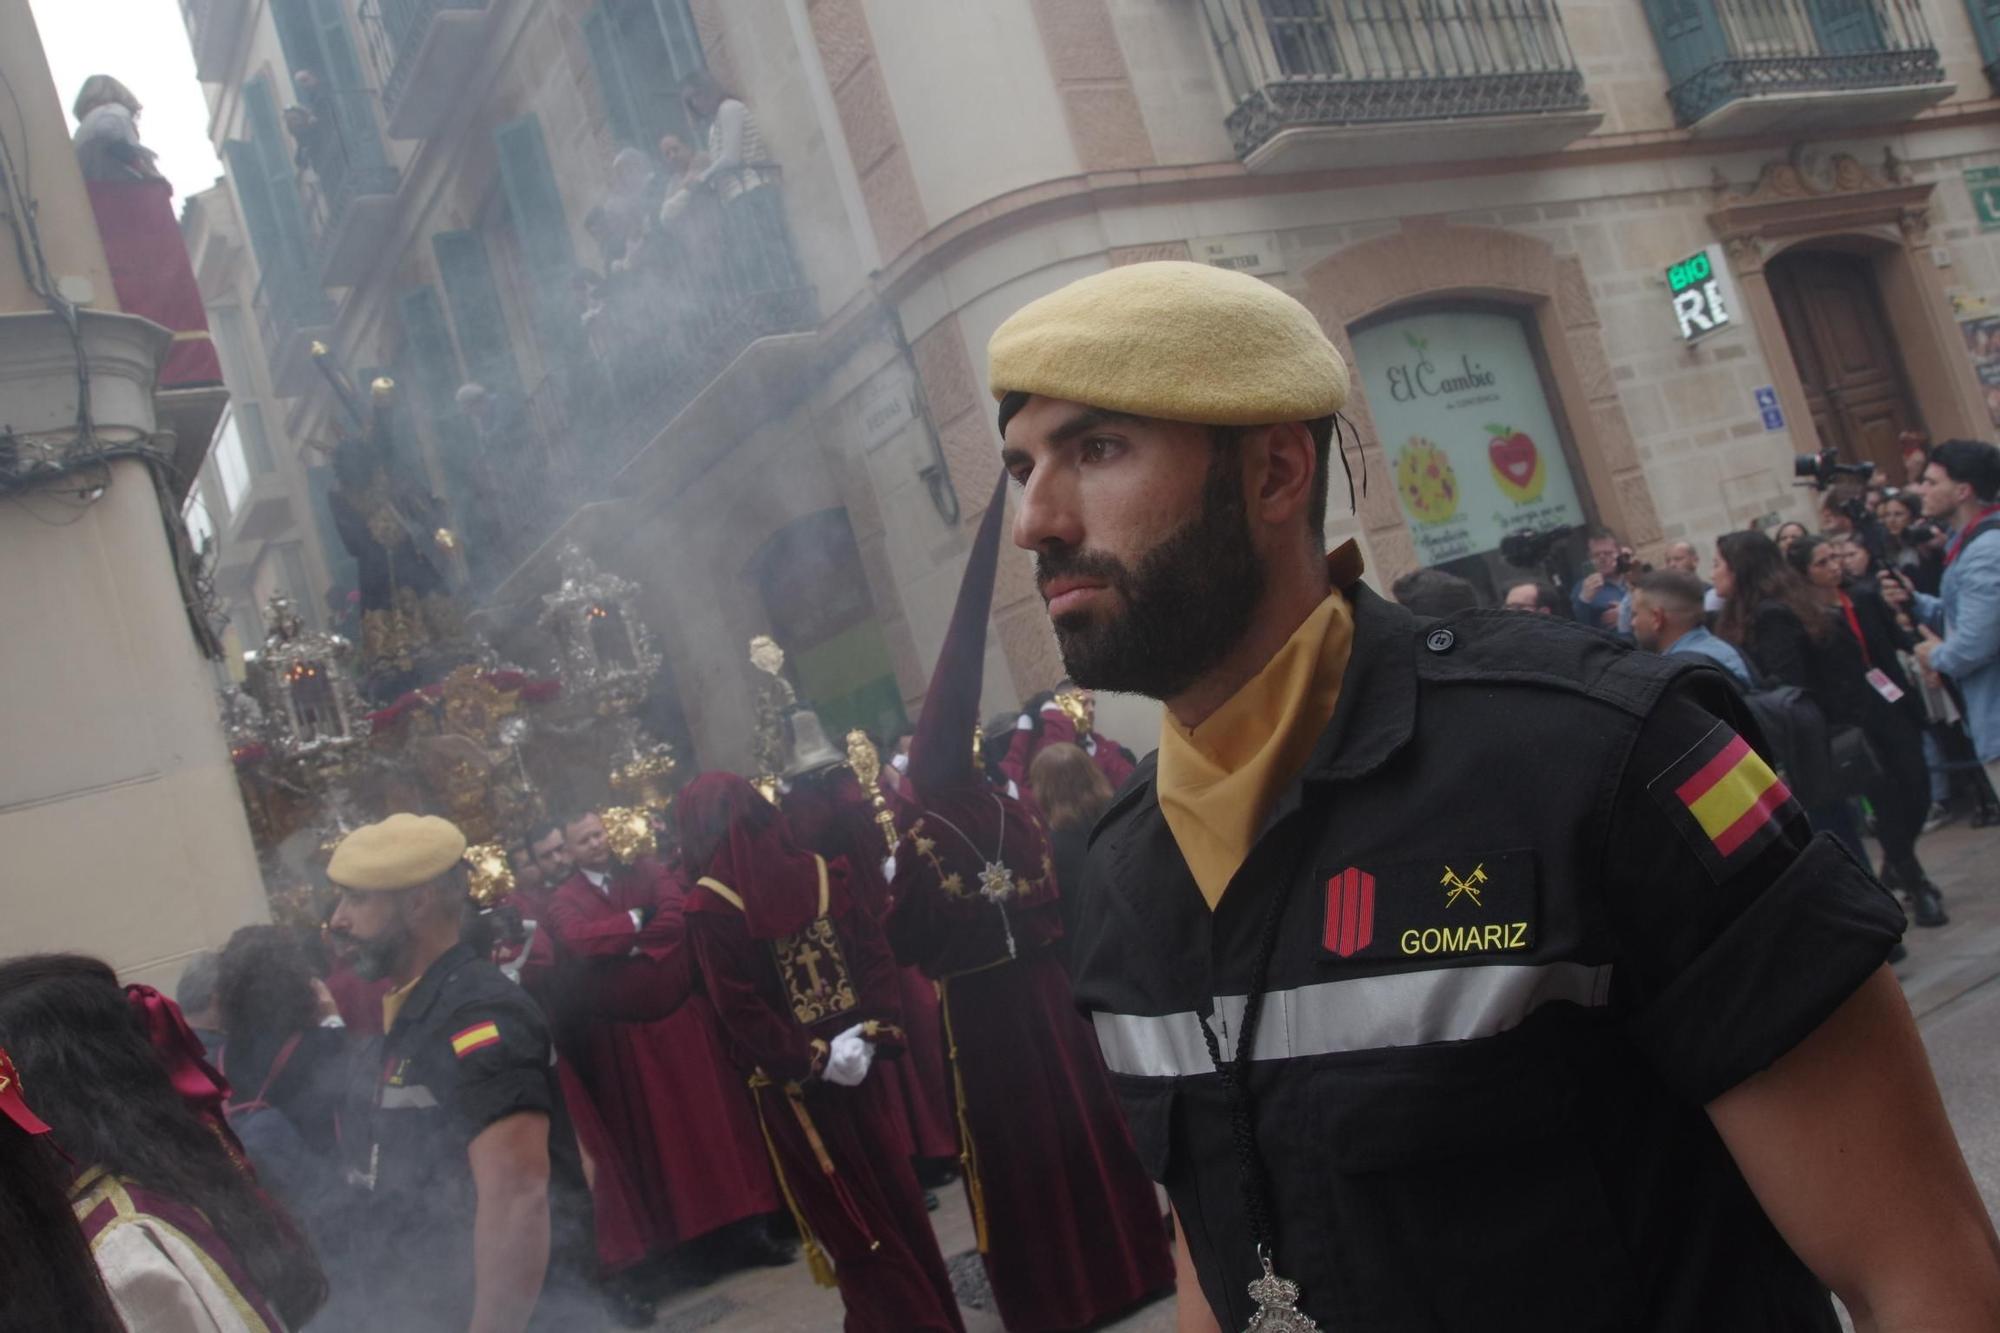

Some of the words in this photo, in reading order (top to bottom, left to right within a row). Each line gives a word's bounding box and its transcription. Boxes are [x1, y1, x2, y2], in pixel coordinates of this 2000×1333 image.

[1668, 253, 1710, 291] BIO
[1673, 280, 1729, 338] RE
[1386, 365, 1416, 402] El
[1415, 354, 1496, 396] Cambio
[1401, 922, 1527, 954] GOMARIZ
